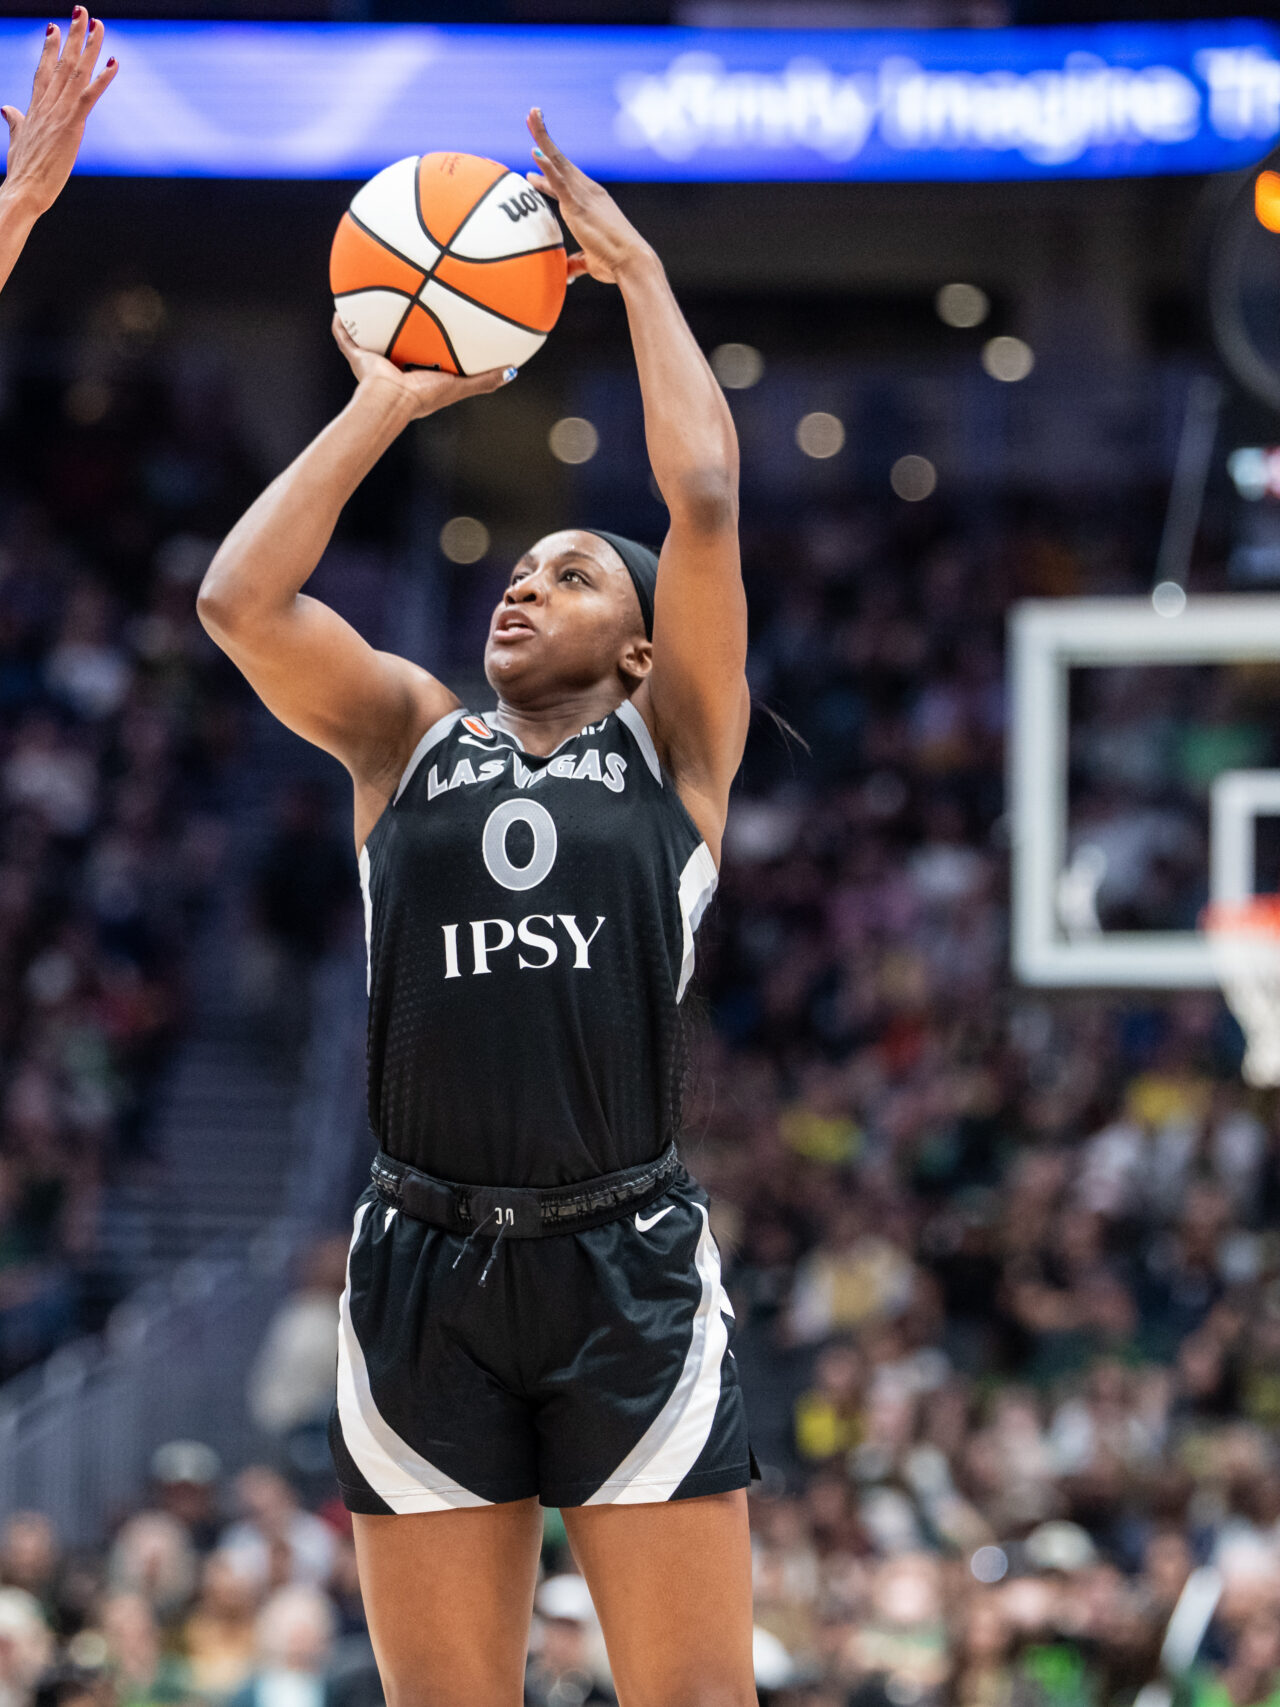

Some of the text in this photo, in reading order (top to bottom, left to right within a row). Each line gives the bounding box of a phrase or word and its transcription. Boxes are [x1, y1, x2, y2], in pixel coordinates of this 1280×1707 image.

[427, 758, 506, 801] LAS
[482, 798, 557, 891] 0
[441, 914, 606, 979] IPSY
